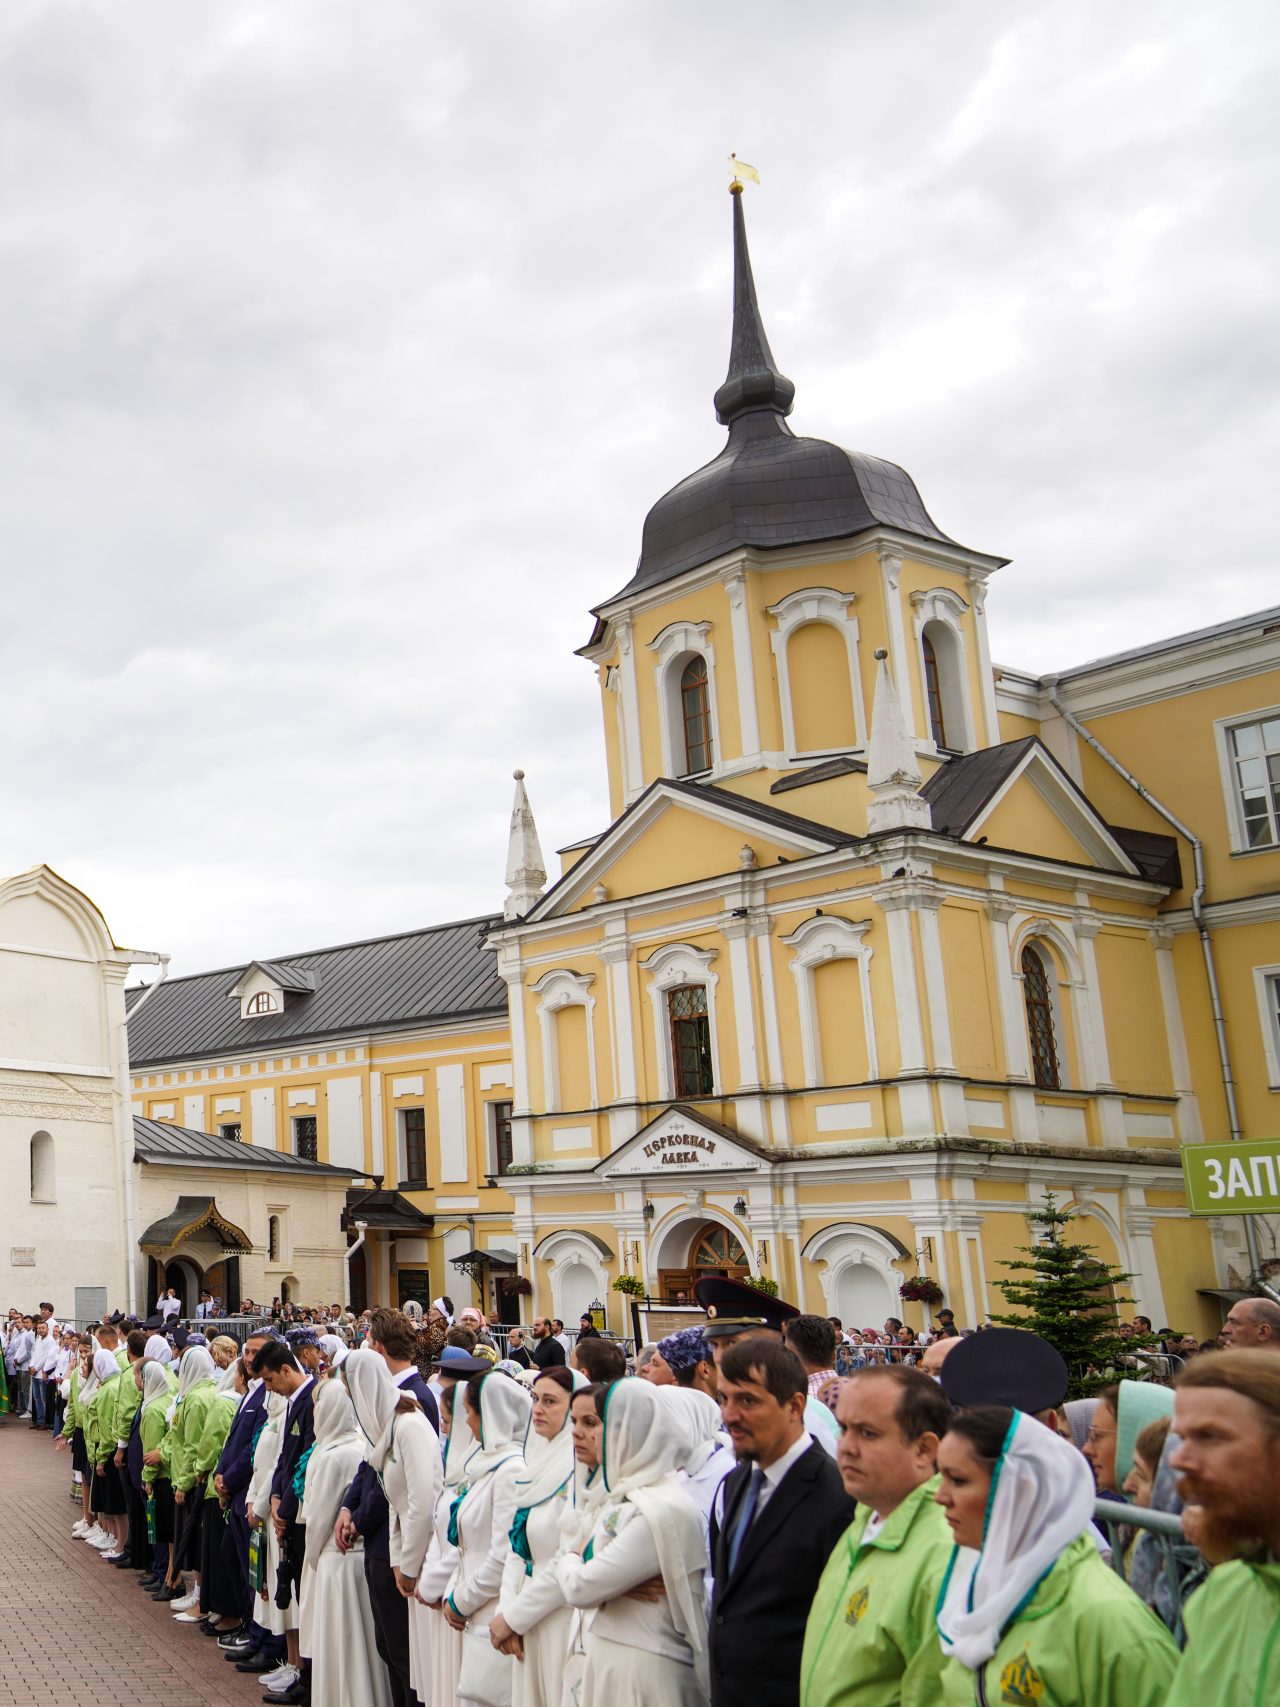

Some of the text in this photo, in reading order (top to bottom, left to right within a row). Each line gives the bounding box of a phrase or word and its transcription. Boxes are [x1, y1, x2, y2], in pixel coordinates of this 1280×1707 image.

[643, 1134, 716, 1157] ЦЕРКОВНАЯ
[661, 1151, 699, 1164] ЛАВКА
[1204, 1155, 1280, 1199] ЗАП
